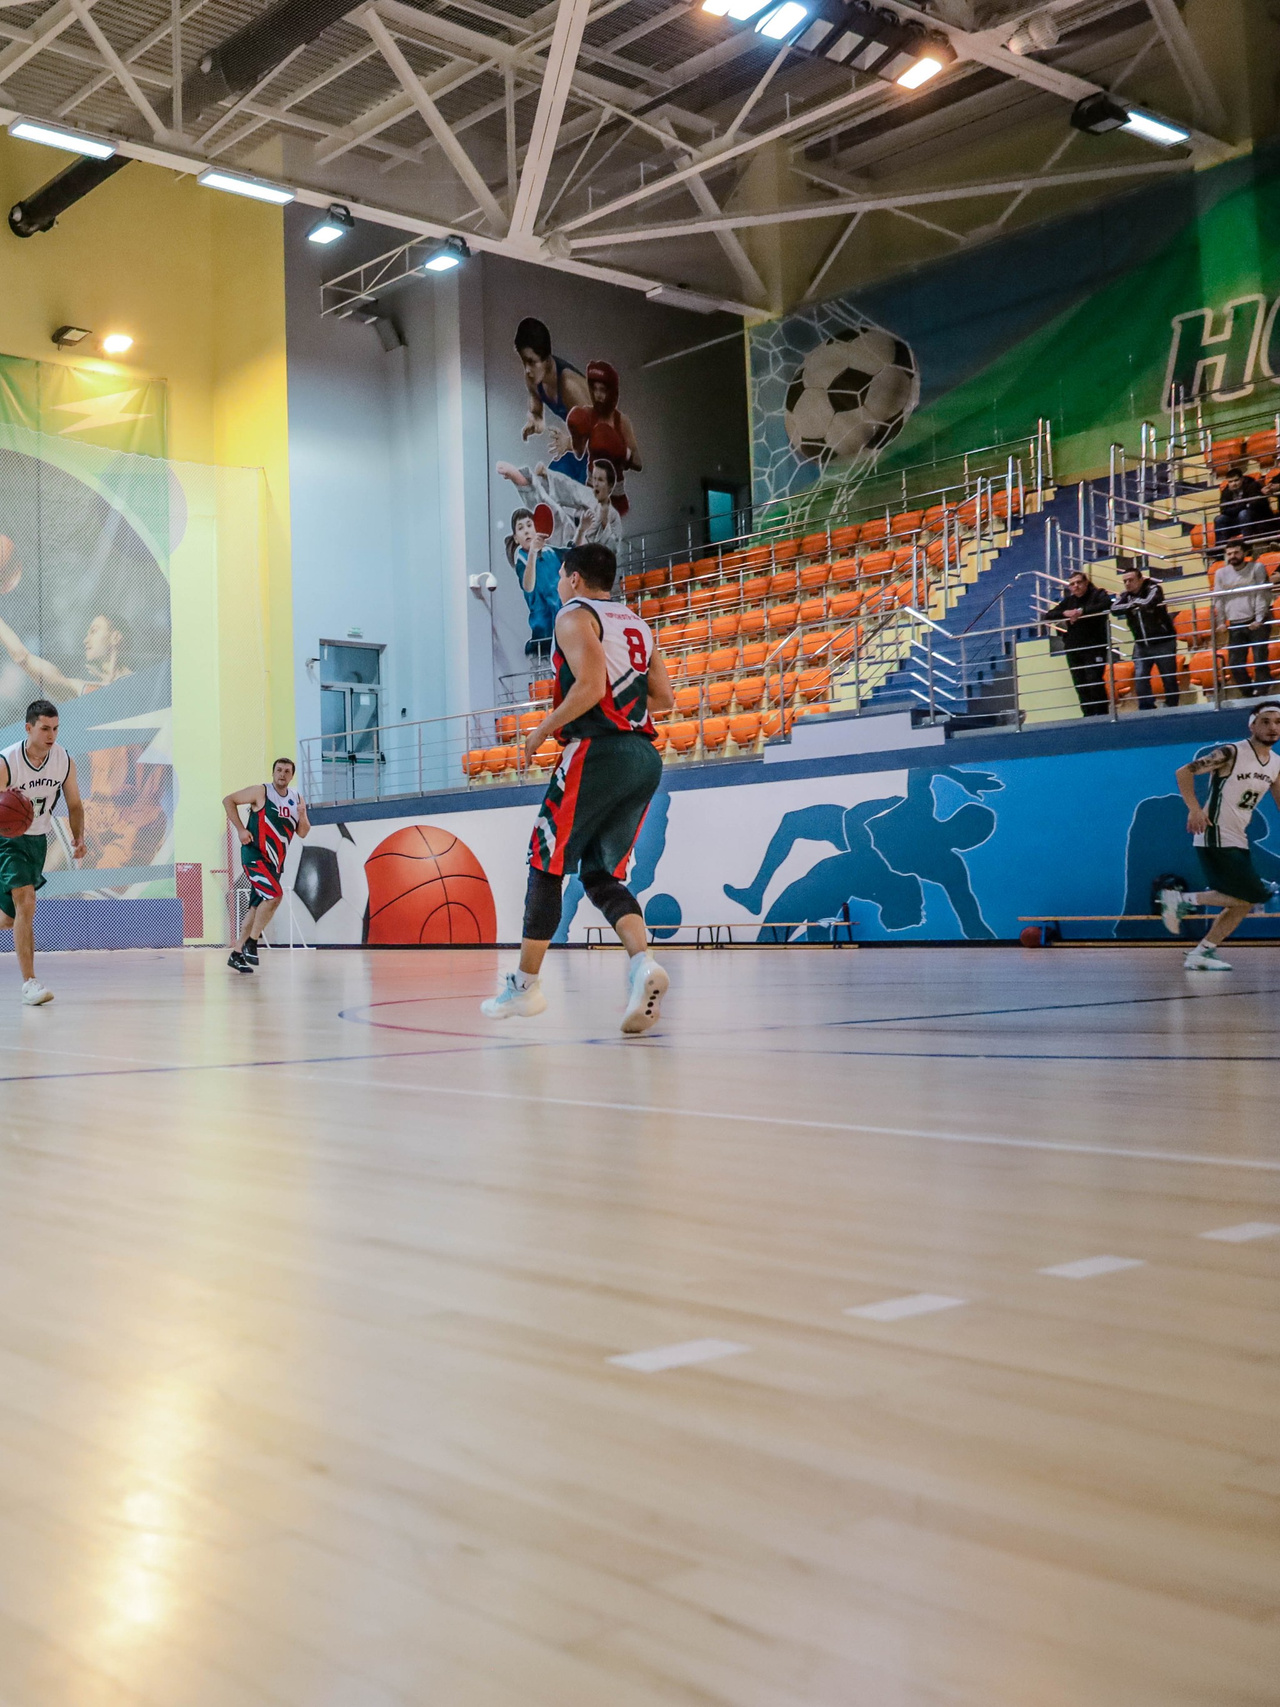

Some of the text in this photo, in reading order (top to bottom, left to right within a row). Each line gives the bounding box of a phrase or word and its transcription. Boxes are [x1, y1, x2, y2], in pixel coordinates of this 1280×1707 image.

[623, 627, 647, 673] 8
[29, 778, 61, 789] ЯНГПУ
[278, 806, 290, 818] 10
